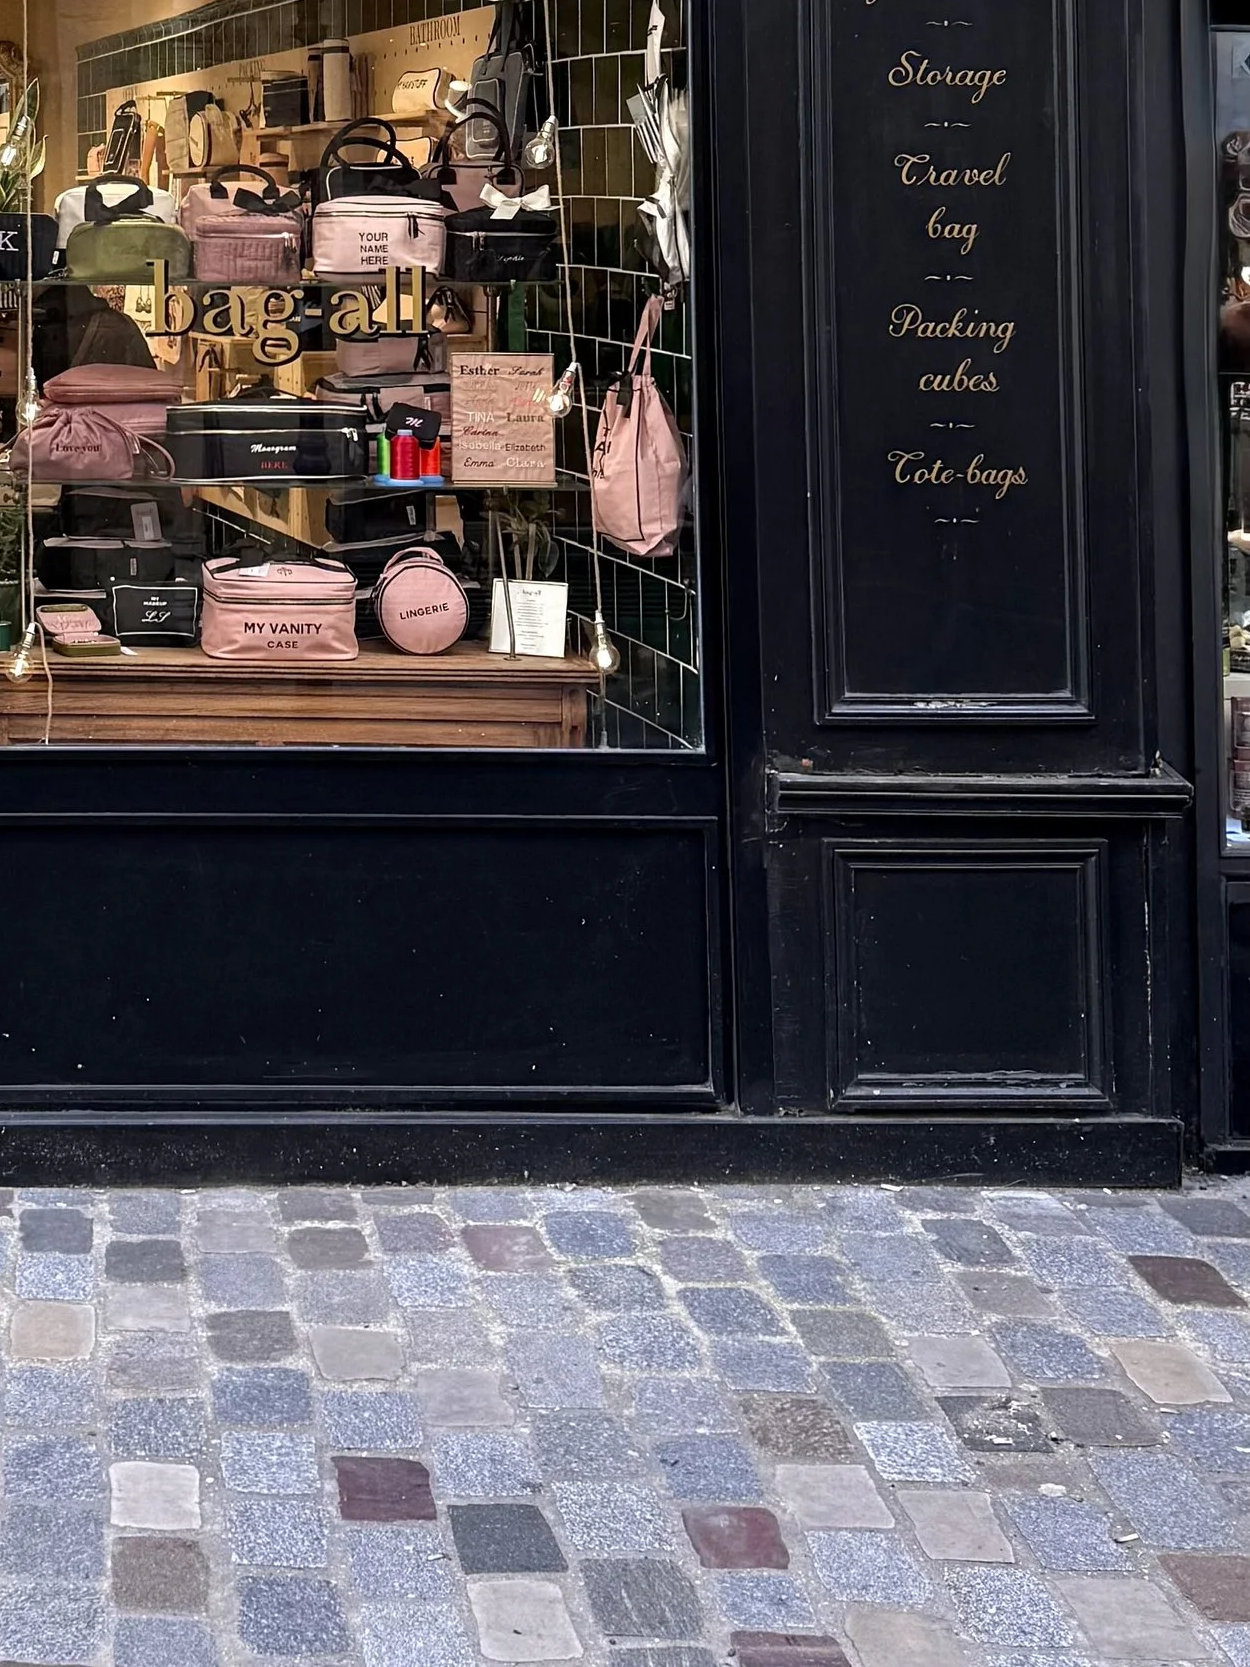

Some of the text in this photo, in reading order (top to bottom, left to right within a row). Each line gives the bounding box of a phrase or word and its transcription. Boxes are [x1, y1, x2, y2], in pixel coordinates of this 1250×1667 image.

[409, 15, 461, 46] BATHROOM
[887, 50, 1007, 104] Storage
[894, 152, 1012, 186] Travel
[925, 206, 980, 255] bag
[358, 232, 389, 242] YOUR
[360, 244, 389, 254] NAME
[360, 256, 389, 265] HERE
[145, 258, 429, 367] bag-all
[888, 303, 1016, 354] Packing
[459, 365, 500, 376] Esther
[918, 358, 1000, 392] cubes
[467, 412, 545, 423] TINA Laura
[250, 443, 297, 454] Monogram
[459, 440, 546, 452] Isabella Elizabeth
[463, 457, 545, 468] Emma Clara
[887, 450, 1029, 500] Tote-bags
[399, 602, 449, 620] LINGERIE
[244, 622, 322, 634] MY VANITY
[267, 640, 299, 649] CASE
